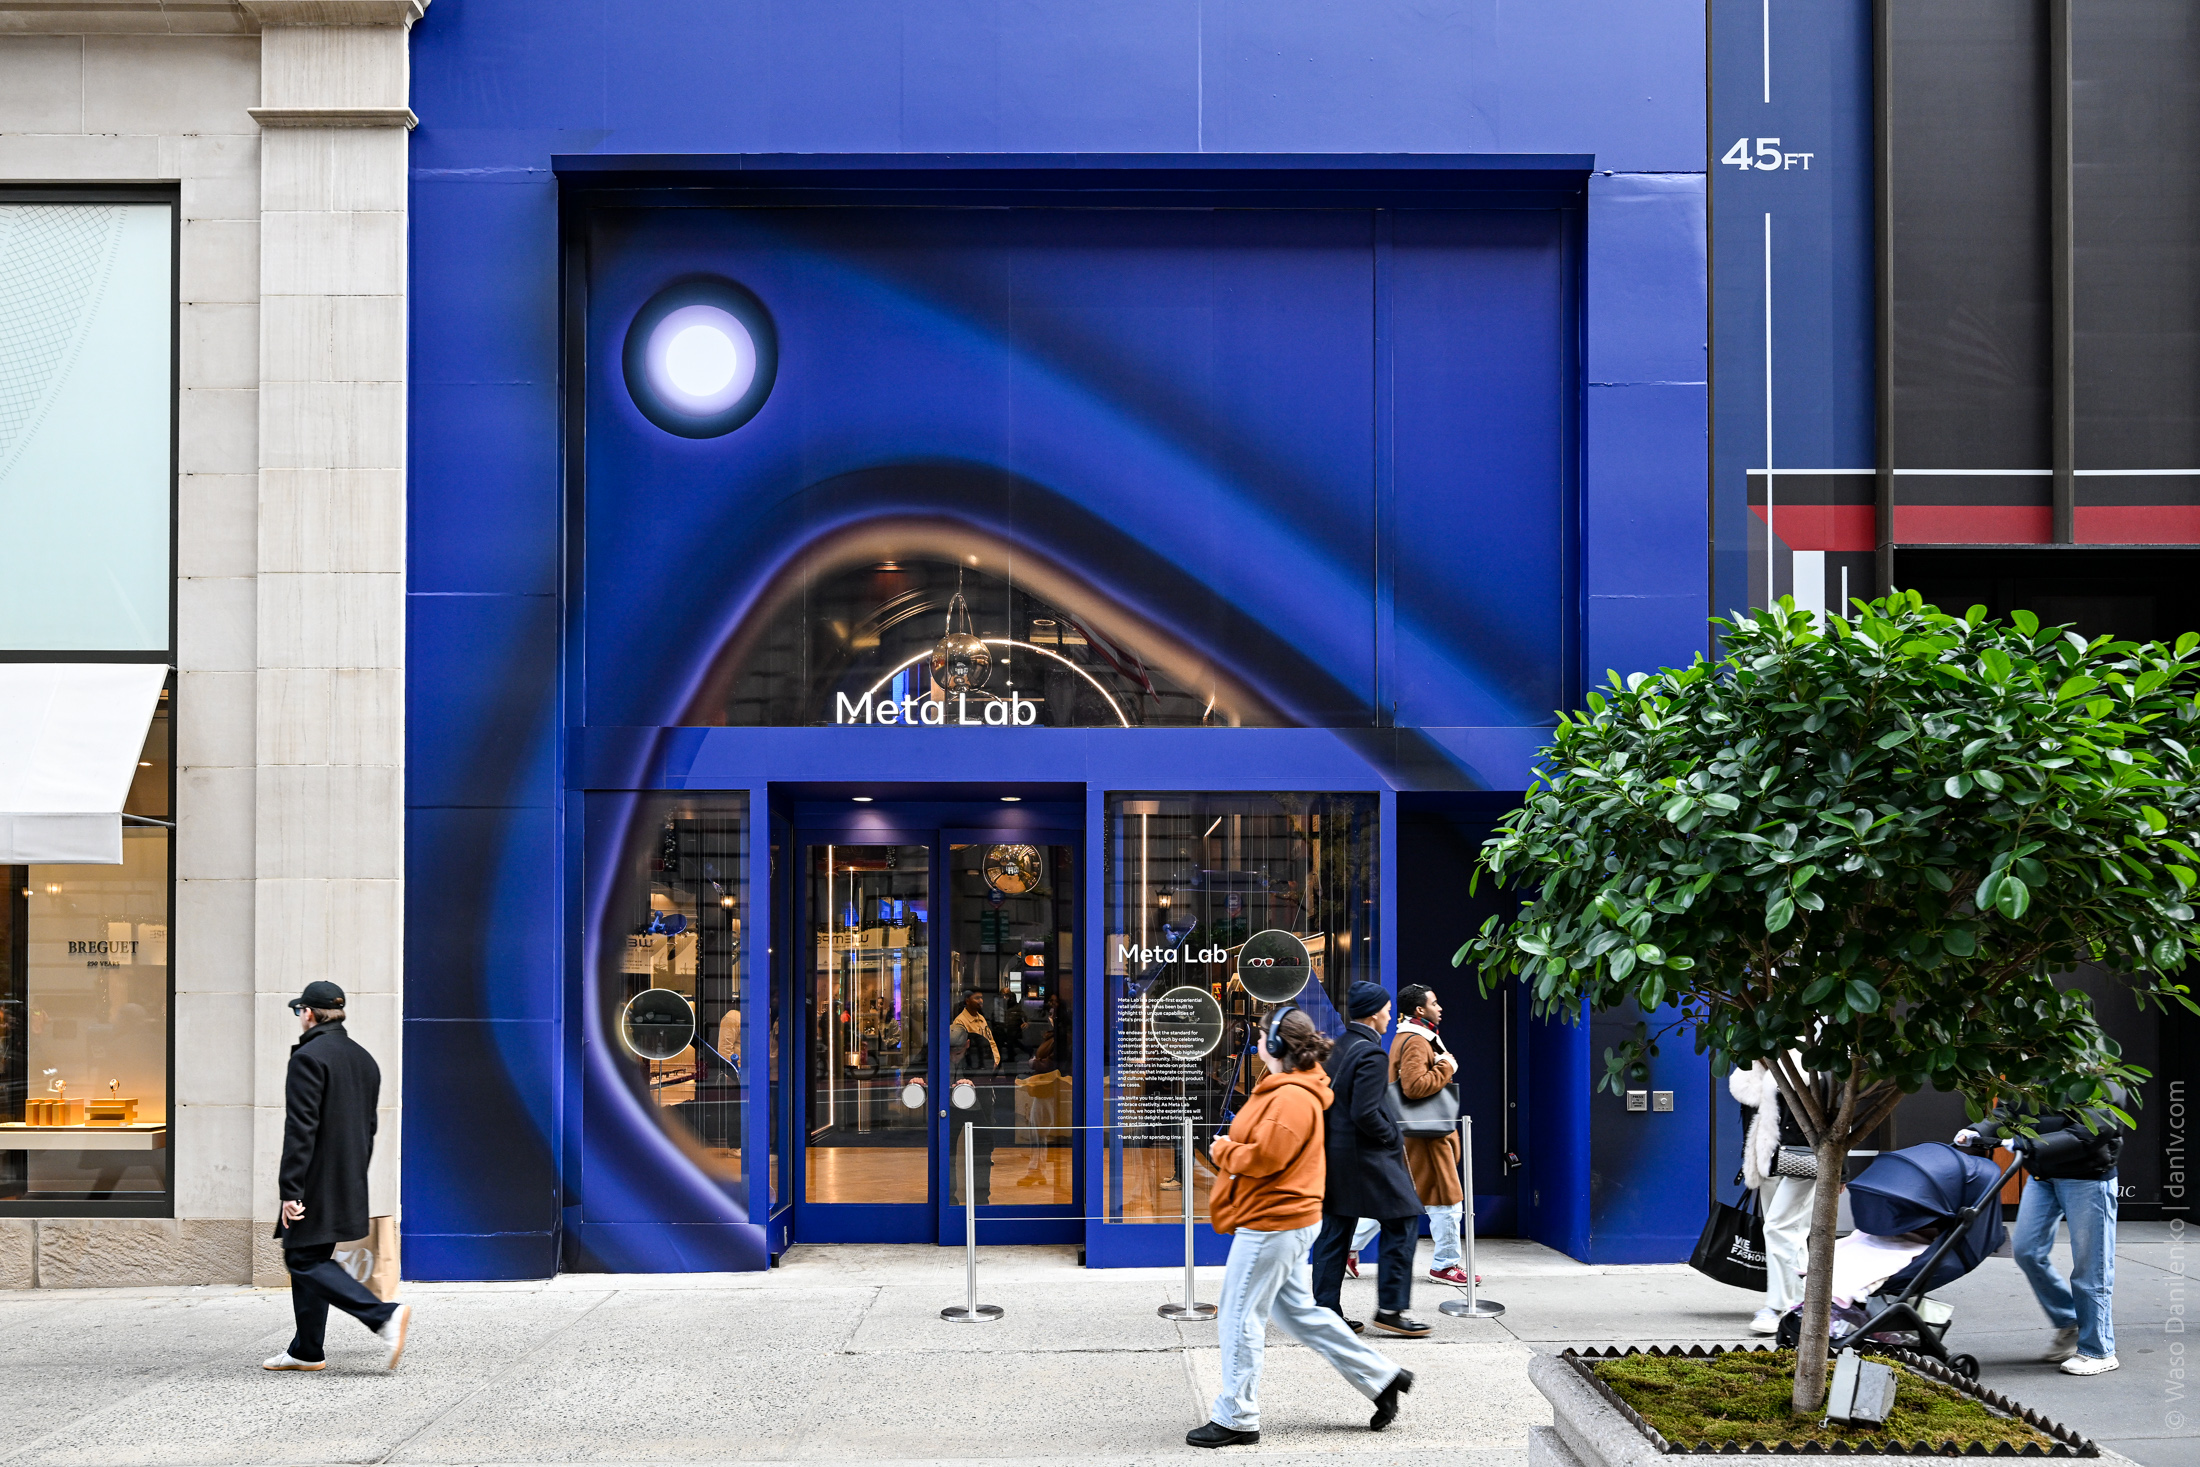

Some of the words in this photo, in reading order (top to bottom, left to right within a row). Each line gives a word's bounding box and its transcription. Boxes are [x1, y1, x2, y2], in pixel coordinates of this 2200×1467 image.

[836, 691, 945, 725] Meta
[959, 691, 1037, 726] Lab
[68, 940, 139, 954] BREGUET
[1118, 943, 1178, 963] Meta
[1184, 943, 1228, 964] Lab
